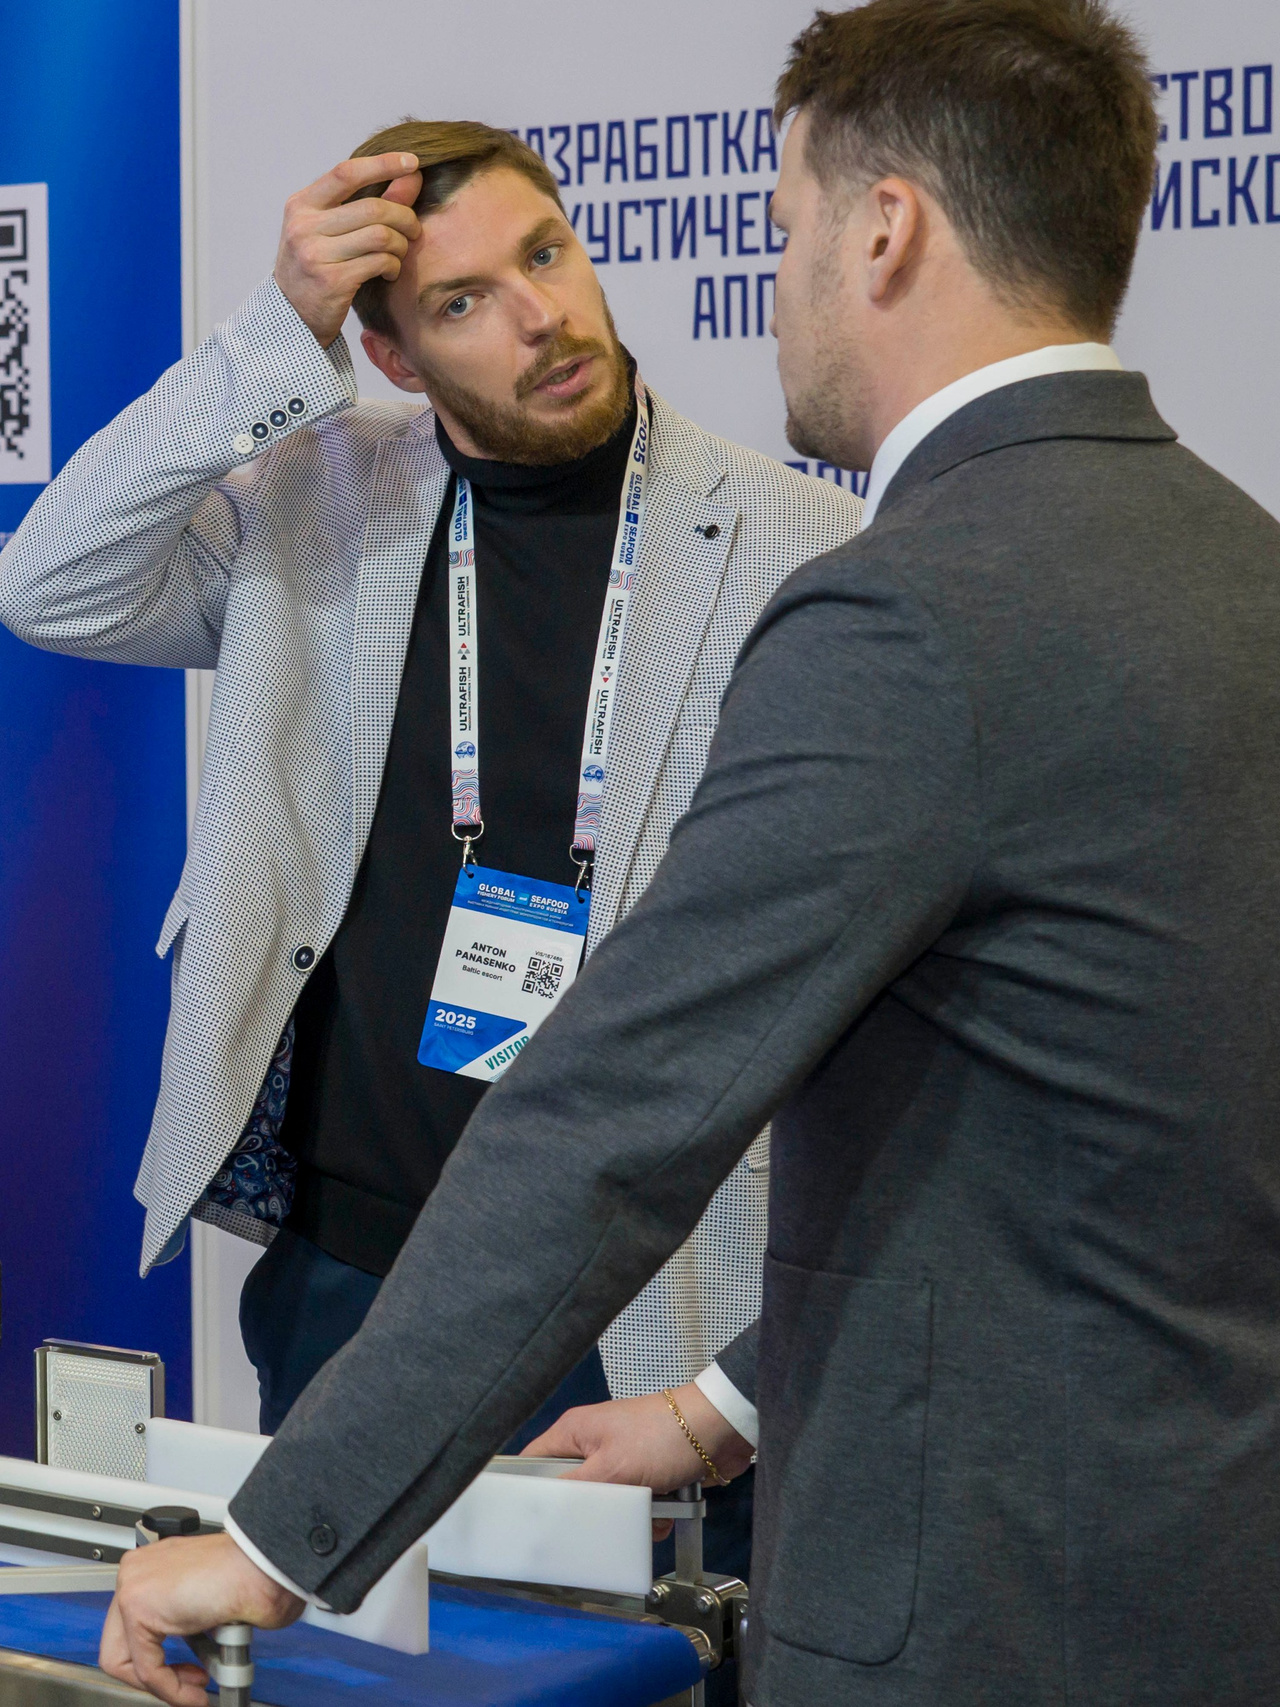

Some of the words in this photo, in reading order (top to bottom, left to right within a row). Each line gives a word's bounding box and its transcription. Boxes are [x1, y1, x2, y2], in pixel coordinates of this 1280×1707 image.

[509, 107, 778, 187] ЗРАБОТКА
[633, 416, 648, 465] 2025
[631, 473, 643, 513] GLOBAL
[454, 505, 464, 542] GLOBAL
[624, 526, 638, 566] SEAFOOD
[458, 576, 467, 637] ULTRAFISH
[607, 600, 624, 660] ULTRAFISH
[458, 667, 467, 731] ULTRAFISH
[593, 690, 609, 755] ULTRAFISH
[478, 883, 516, 898] GLOBAL
[530, 895, 570, 910] SEAFOOD
[546, 906, 568, 915] RUSSIA
[455, 949, 516, 973] PANASENKO
[471, 941, 507, 958] ANTON
[462, 964, 481, 976] Baltic
[481, 971, 503, 982] escort
[434, 1008, 477, 1029] 2025
